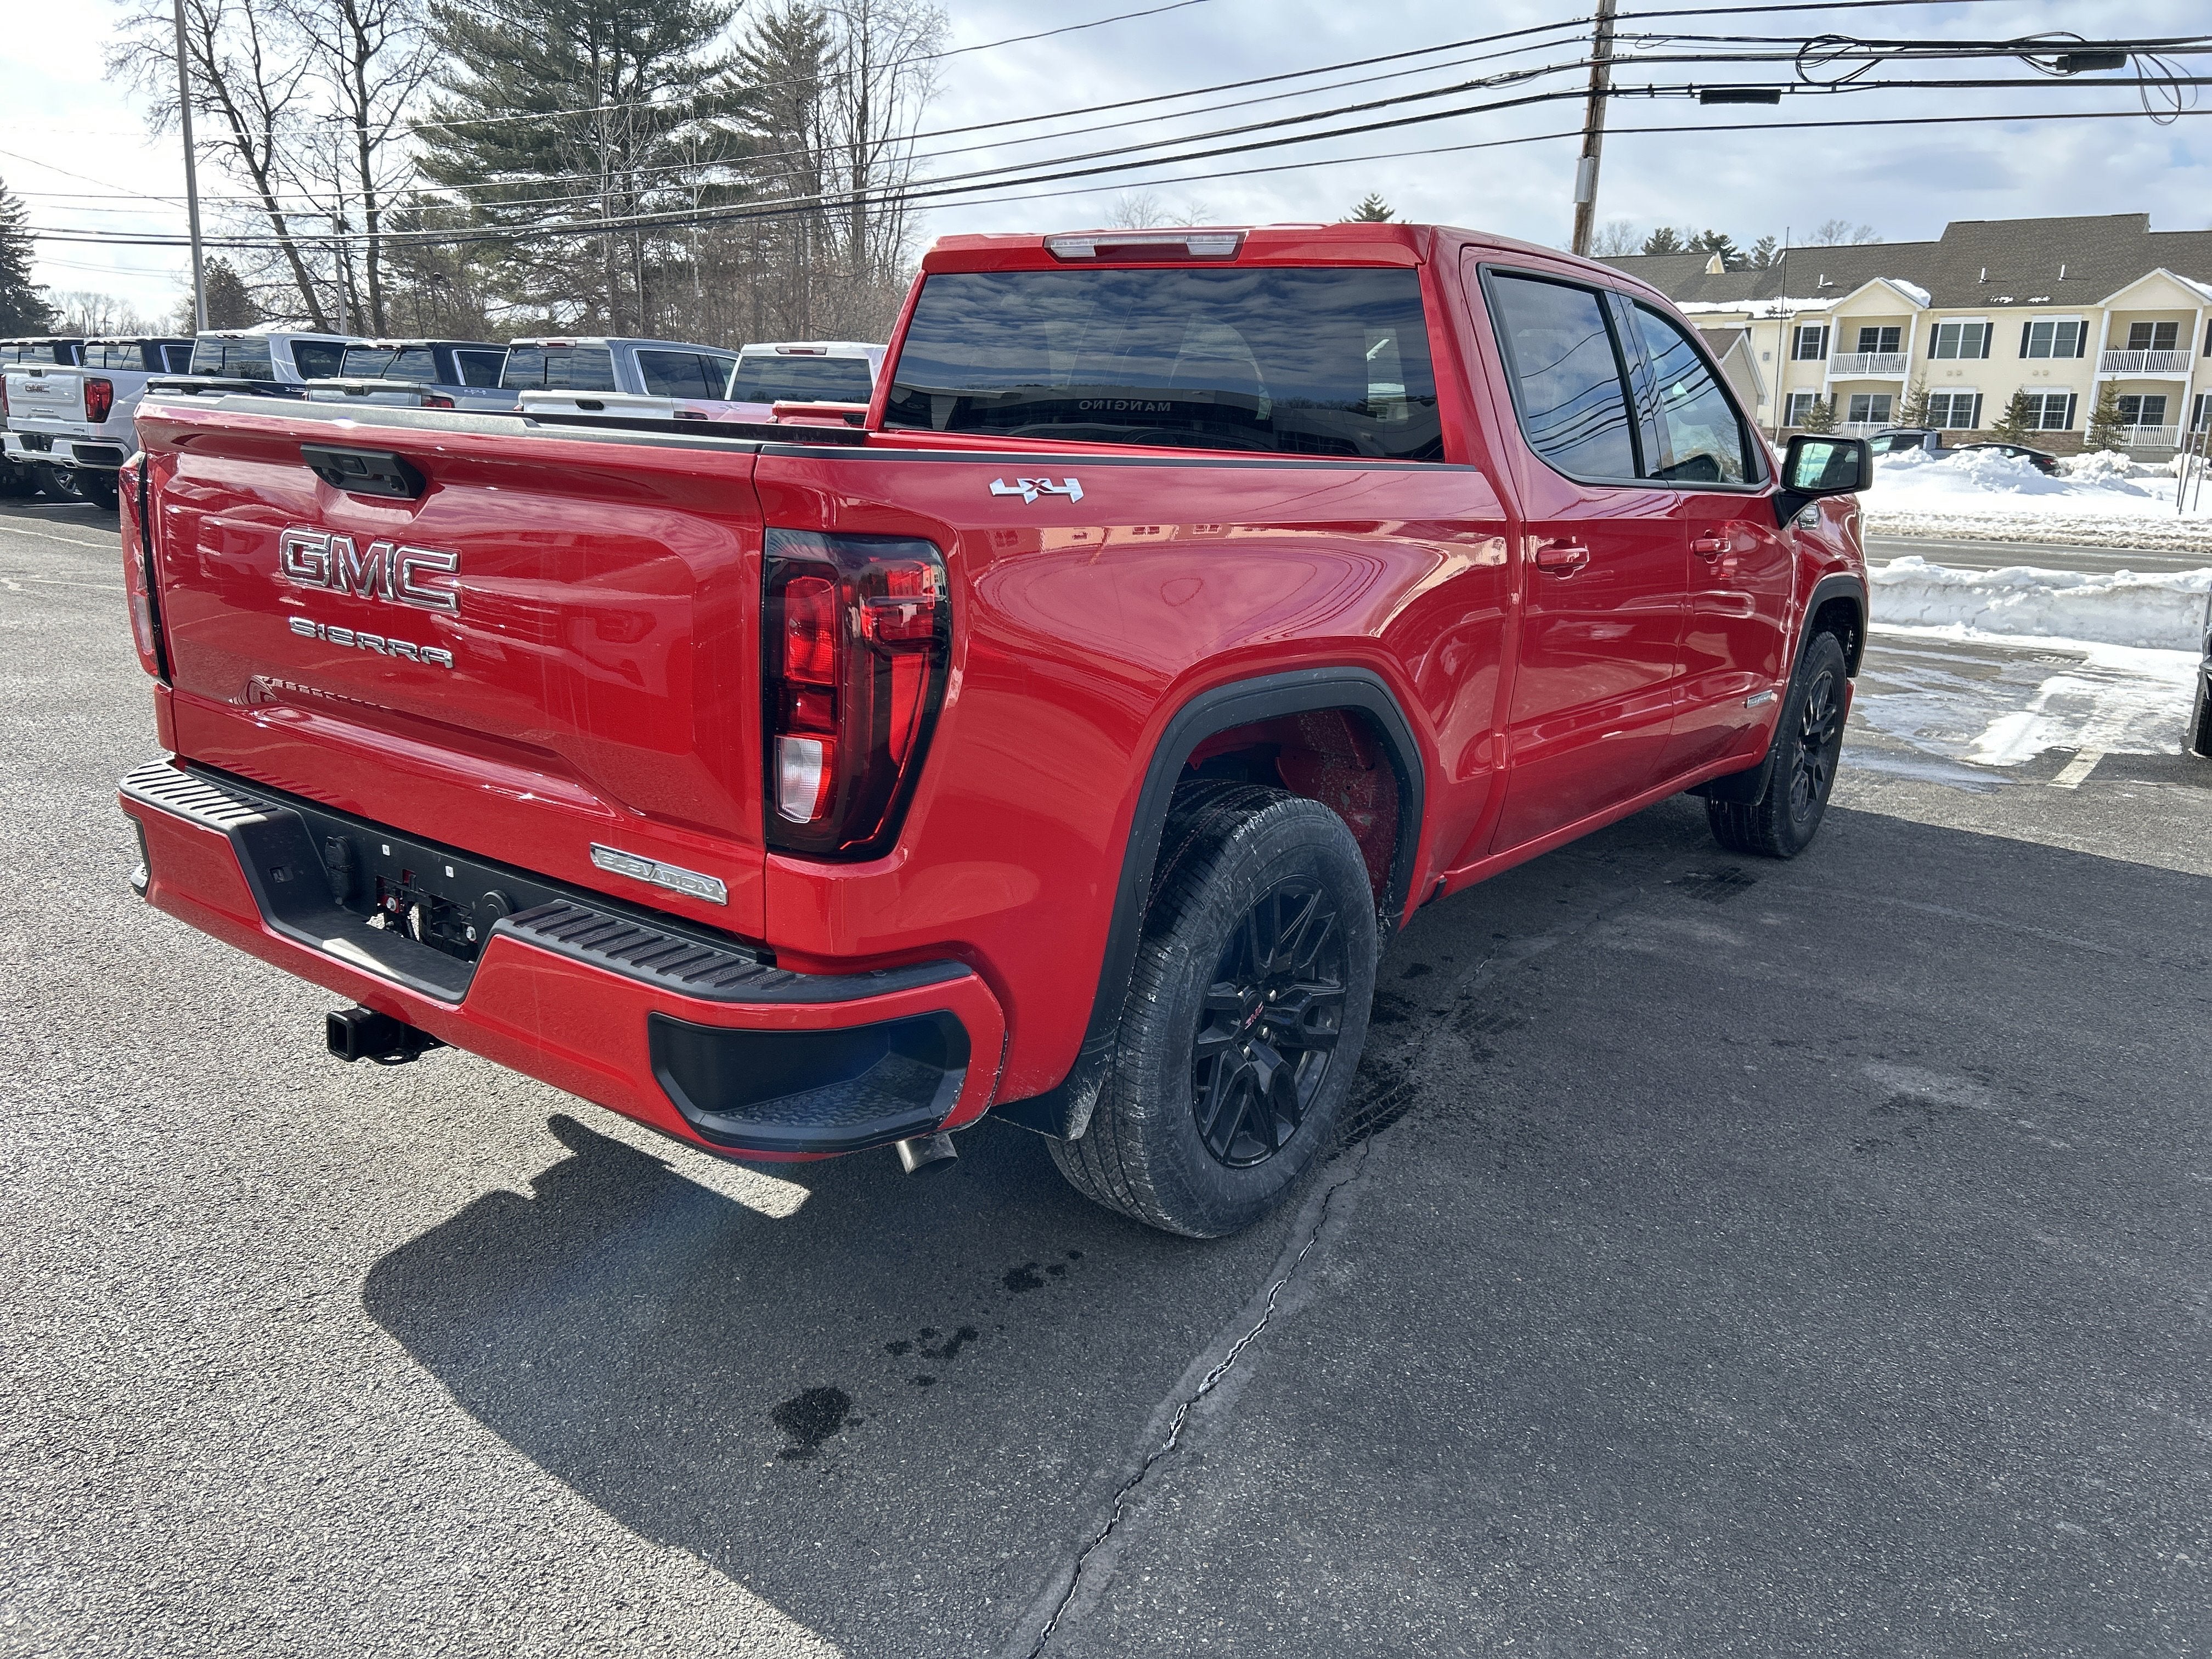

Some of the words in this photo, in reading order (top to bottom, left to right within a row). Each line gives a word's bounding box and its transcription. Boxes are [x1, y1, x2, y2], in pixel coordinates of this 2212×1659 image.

[279, 525, 462, 616] GMC
[289, 616, 455, 669] SIERRA
[599, 851, 715, 893] ELEVATION
